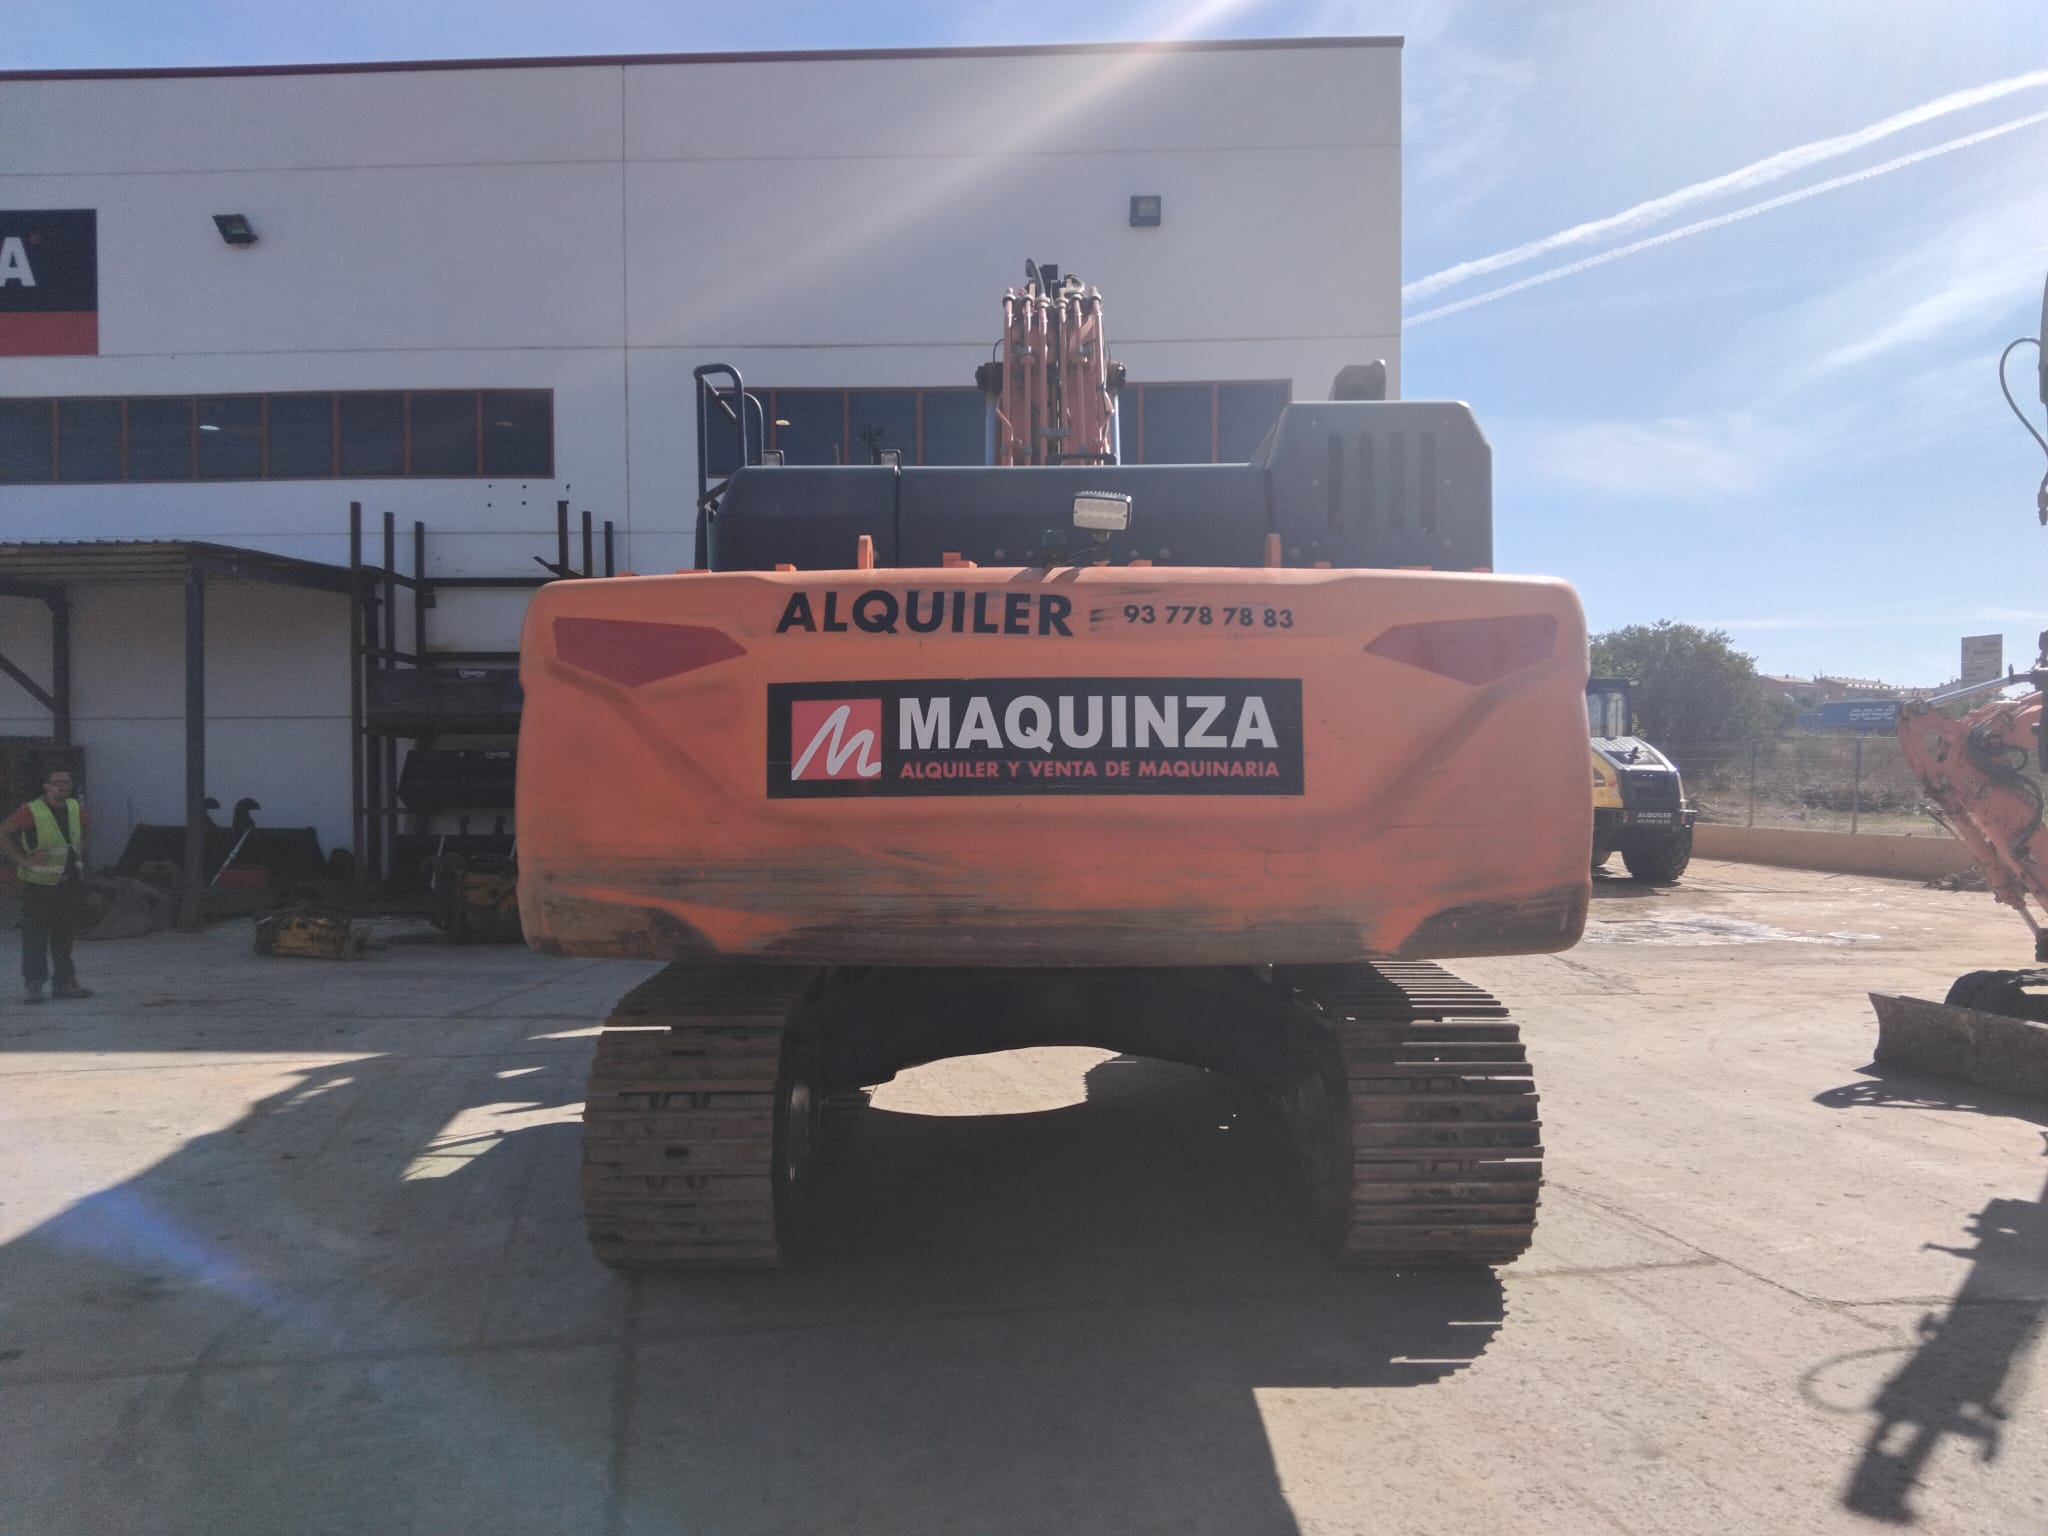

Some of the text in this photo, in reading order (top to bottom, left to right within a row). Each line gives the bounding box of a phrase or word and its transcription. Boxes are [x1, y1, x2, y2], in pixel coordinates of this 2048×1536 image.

[775, 589, 1074, 637] ALQUILER
[1123, 604, 1294, 629] 93 778 78 83
[899, 695, 1279, 753] MAQUINZA
[900, 760, 1280, 779] ALQUILER Y VENTA DE MAQUINARIA
